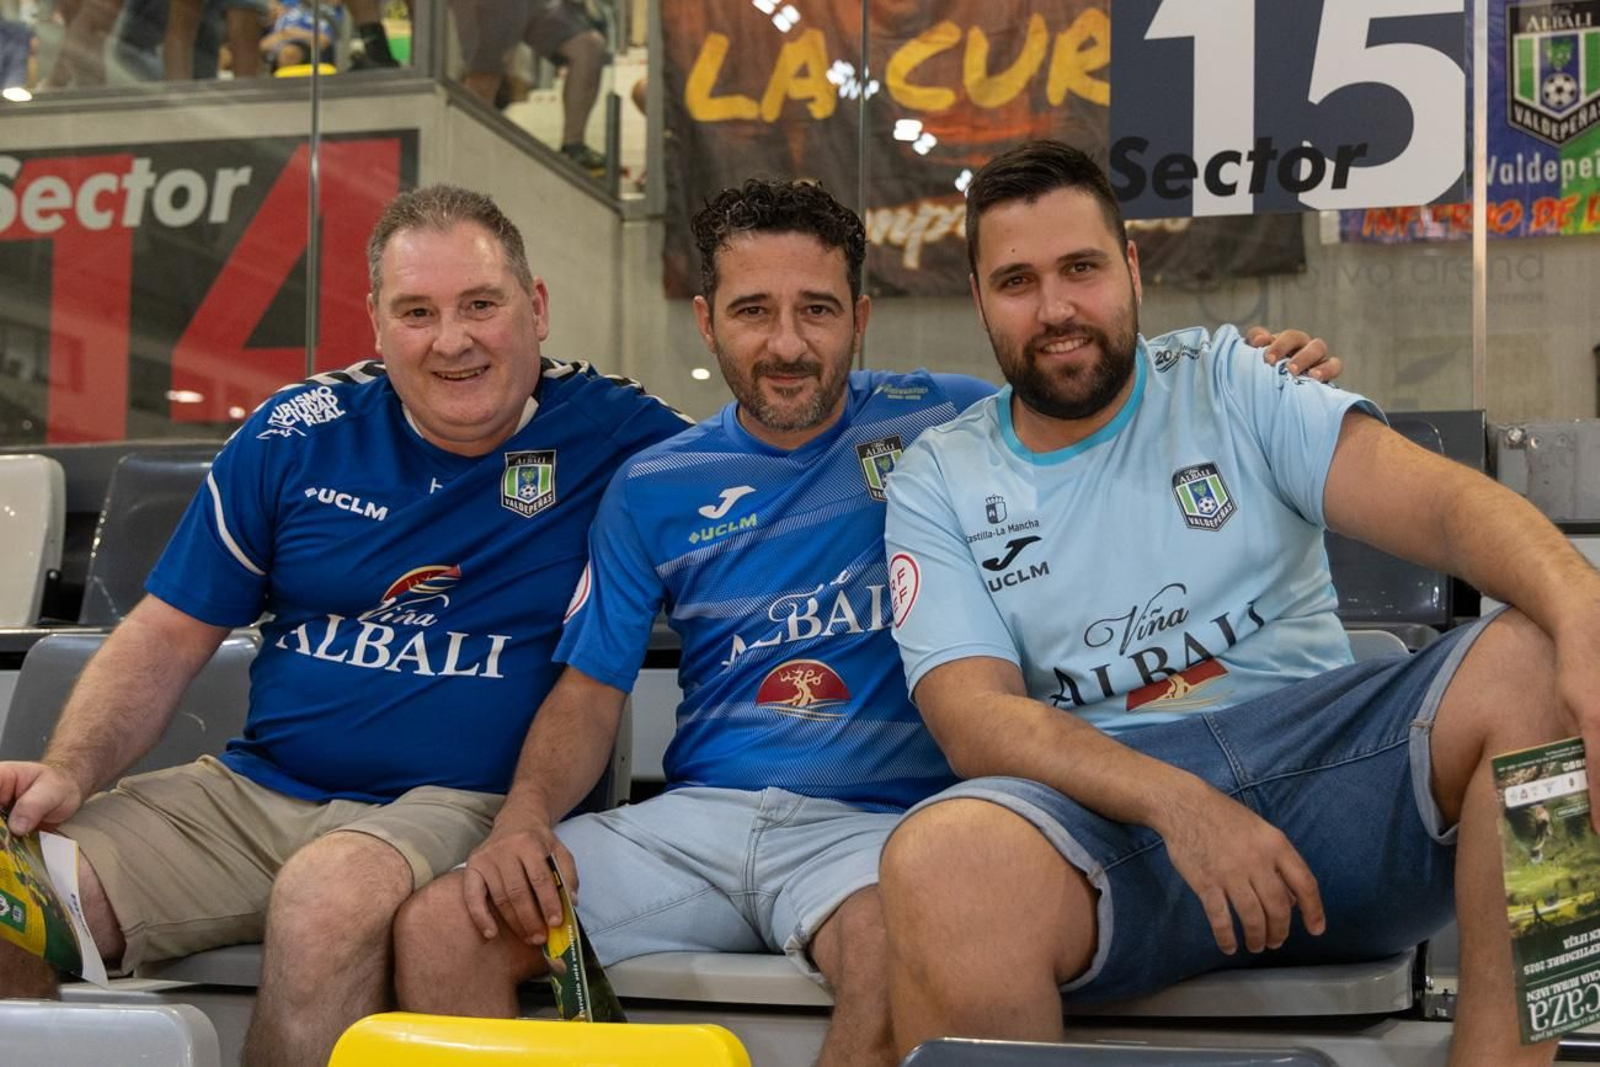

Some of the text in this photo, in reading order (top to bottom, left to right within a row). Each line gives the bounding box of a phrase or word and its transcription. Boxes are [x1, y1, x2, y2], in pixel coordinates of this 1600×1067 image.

[685, 28, 836, 122] LA
[1145, 0, 1466, 216] 15
[1514, 98, 1600, 141] VALDEPEÑA
[1110, 136, 1368, 201] Sector
[267, 386, 332, 425] TURISMO
[281, 395, 339, 427] CIUDAD
[303, 409, 346, 428] REAL
[317, 487, 389, 521] UCLM
[700, 512, 757, 542] UCLM
[1007, 519, 1040, 533] Mancha
[987, 560, 1050, 592] UCLM
[1084, 583, 1189, 656] Viña
[275, 613, 512, 678] ALBALI
[1528, 982, 1600, 1032] caza
